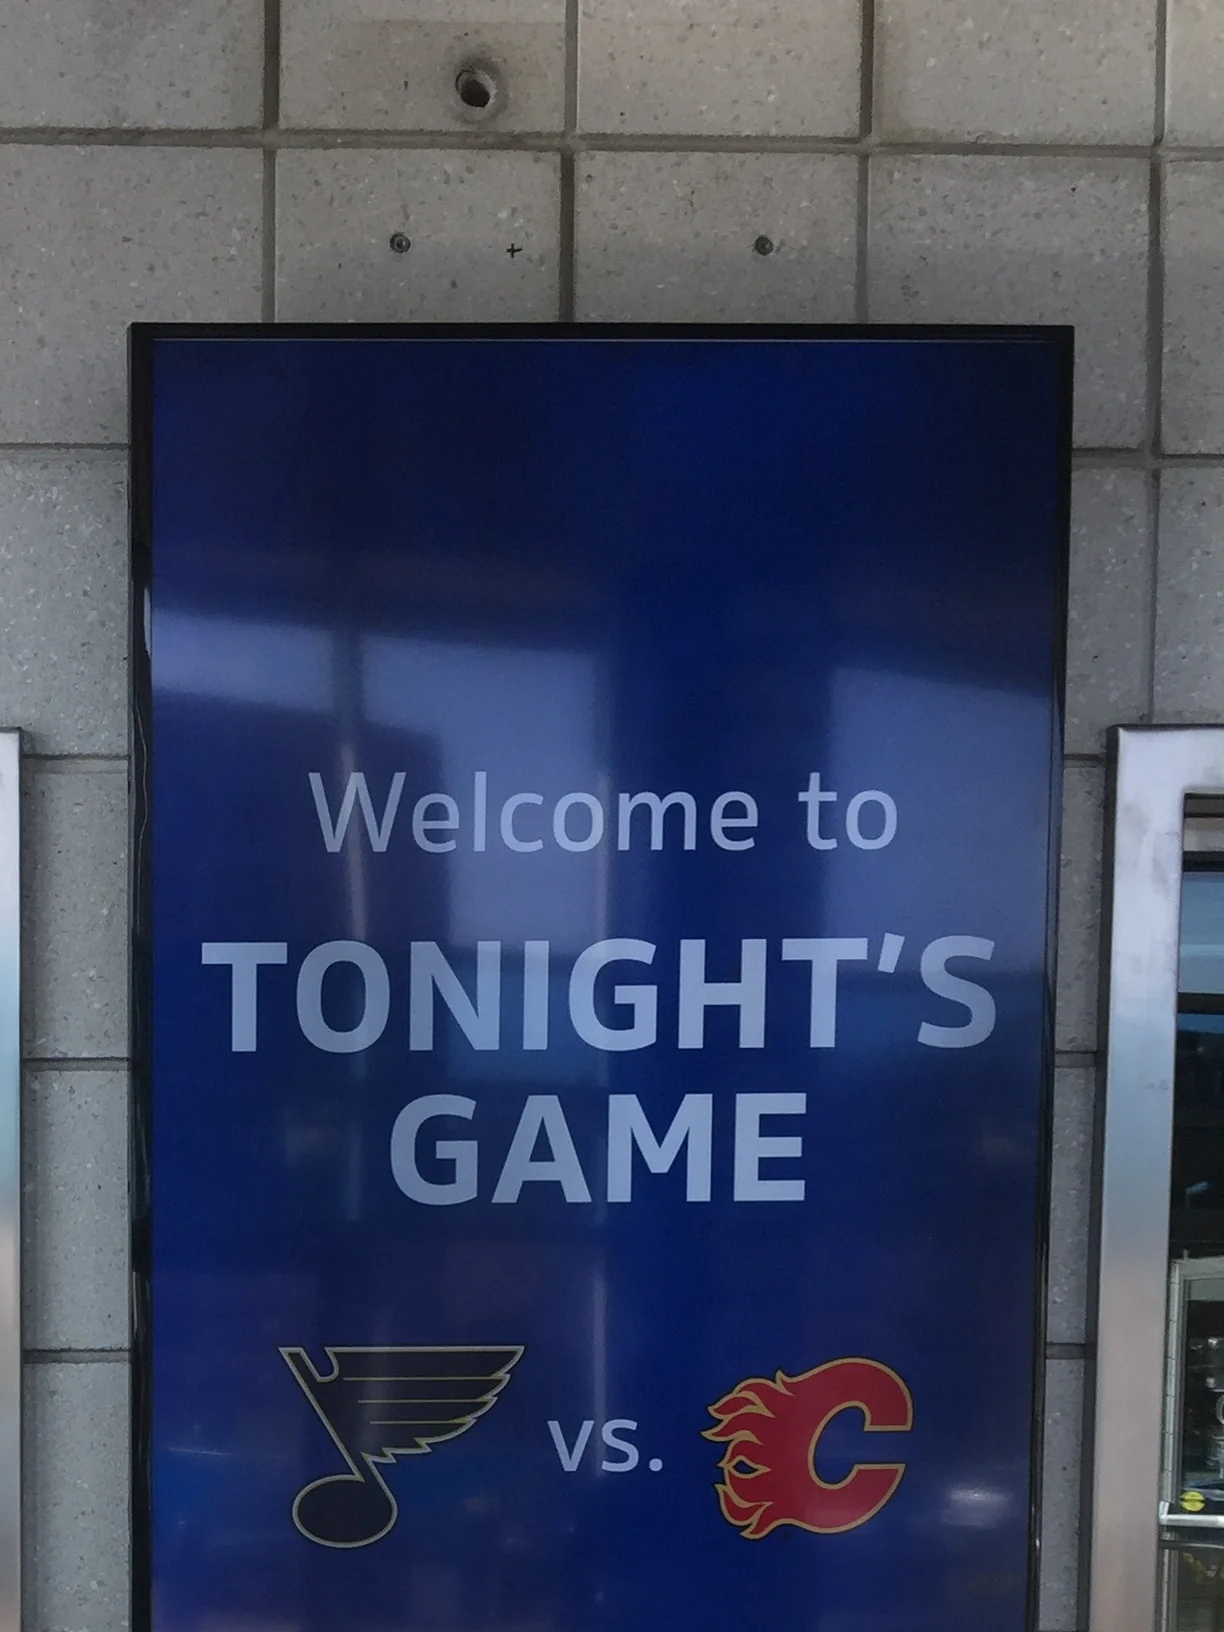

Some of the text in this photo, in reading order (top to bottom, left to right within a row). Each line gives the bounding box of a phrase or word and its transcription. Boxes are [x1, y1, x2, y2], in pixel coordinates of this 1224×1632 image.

[308, 771, 899, 854] Welcome to
[201, 933, 997, 1053] TONIGHT'S
[389, 1092, 808, 1206] GAME
[547, 1419, 664, 1472] vs.
